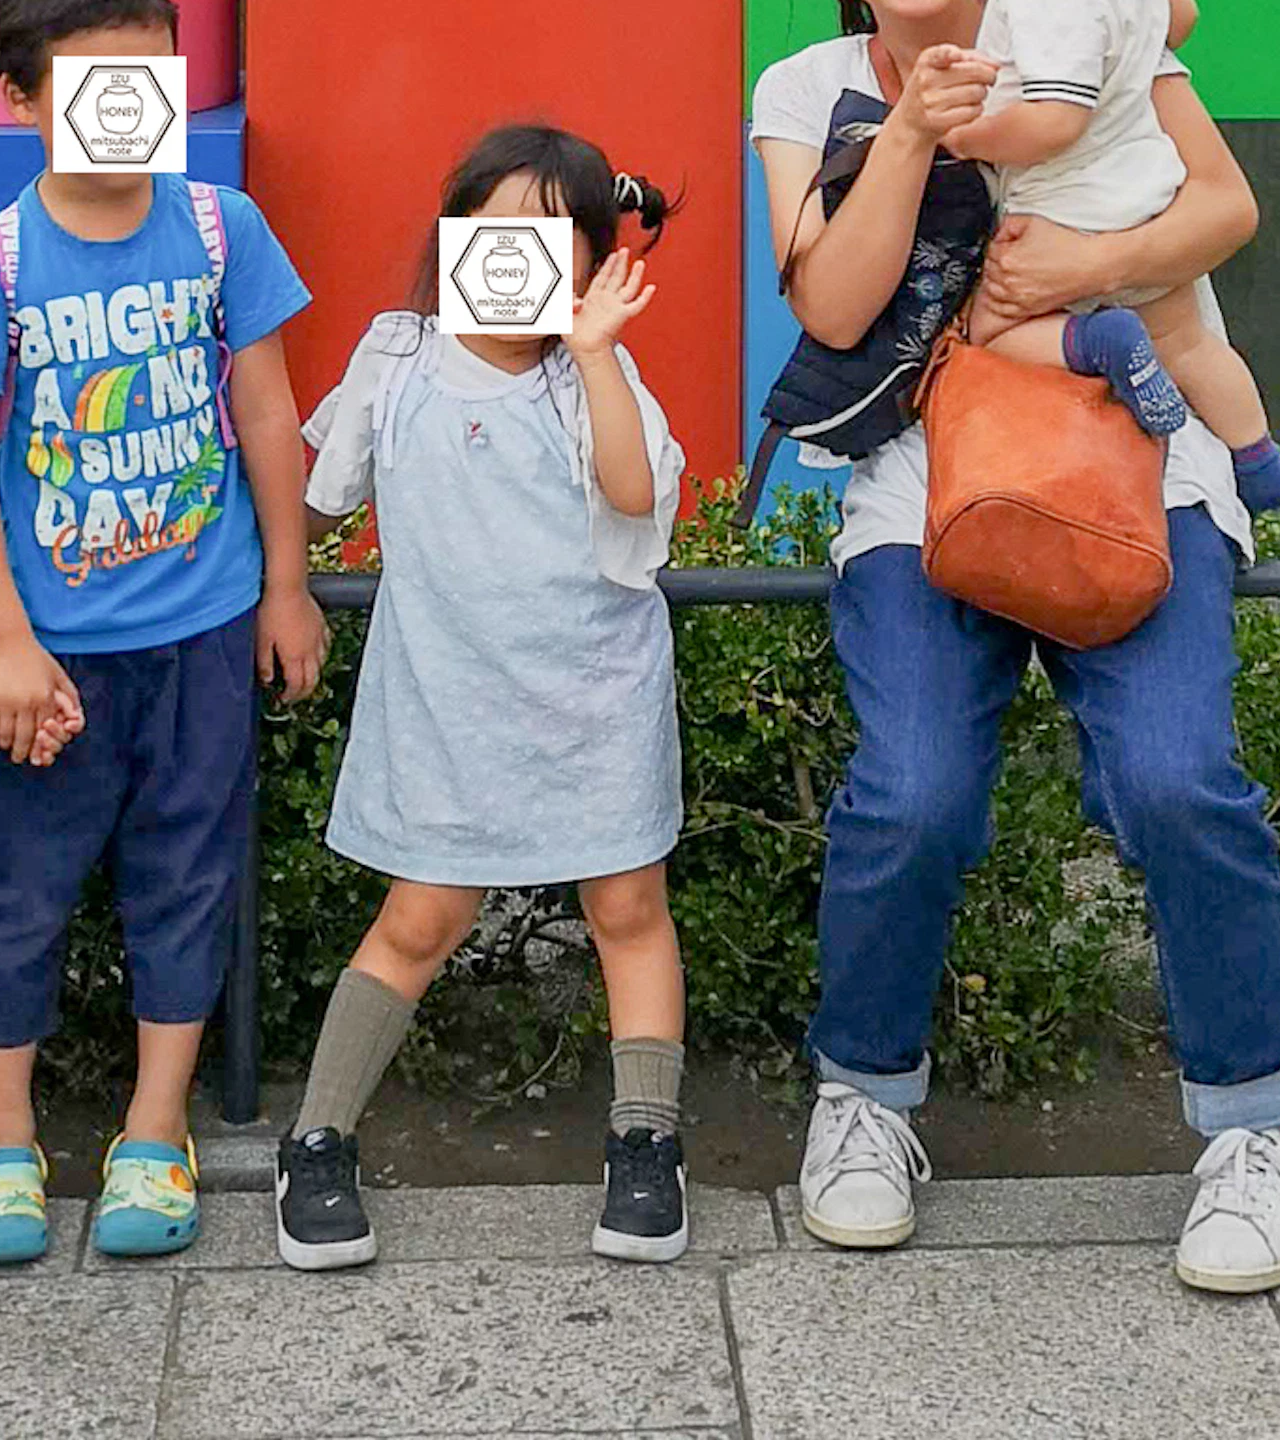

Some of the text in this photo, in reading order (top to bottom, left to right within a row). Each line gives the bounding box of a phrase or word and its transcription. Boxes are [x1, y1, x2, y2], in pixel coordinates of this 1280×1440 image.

[16, 279, 214, 368] BRIGHT
[79, 405, 214, 483] SUNNY
[34, 479, 173, 551] DAY
